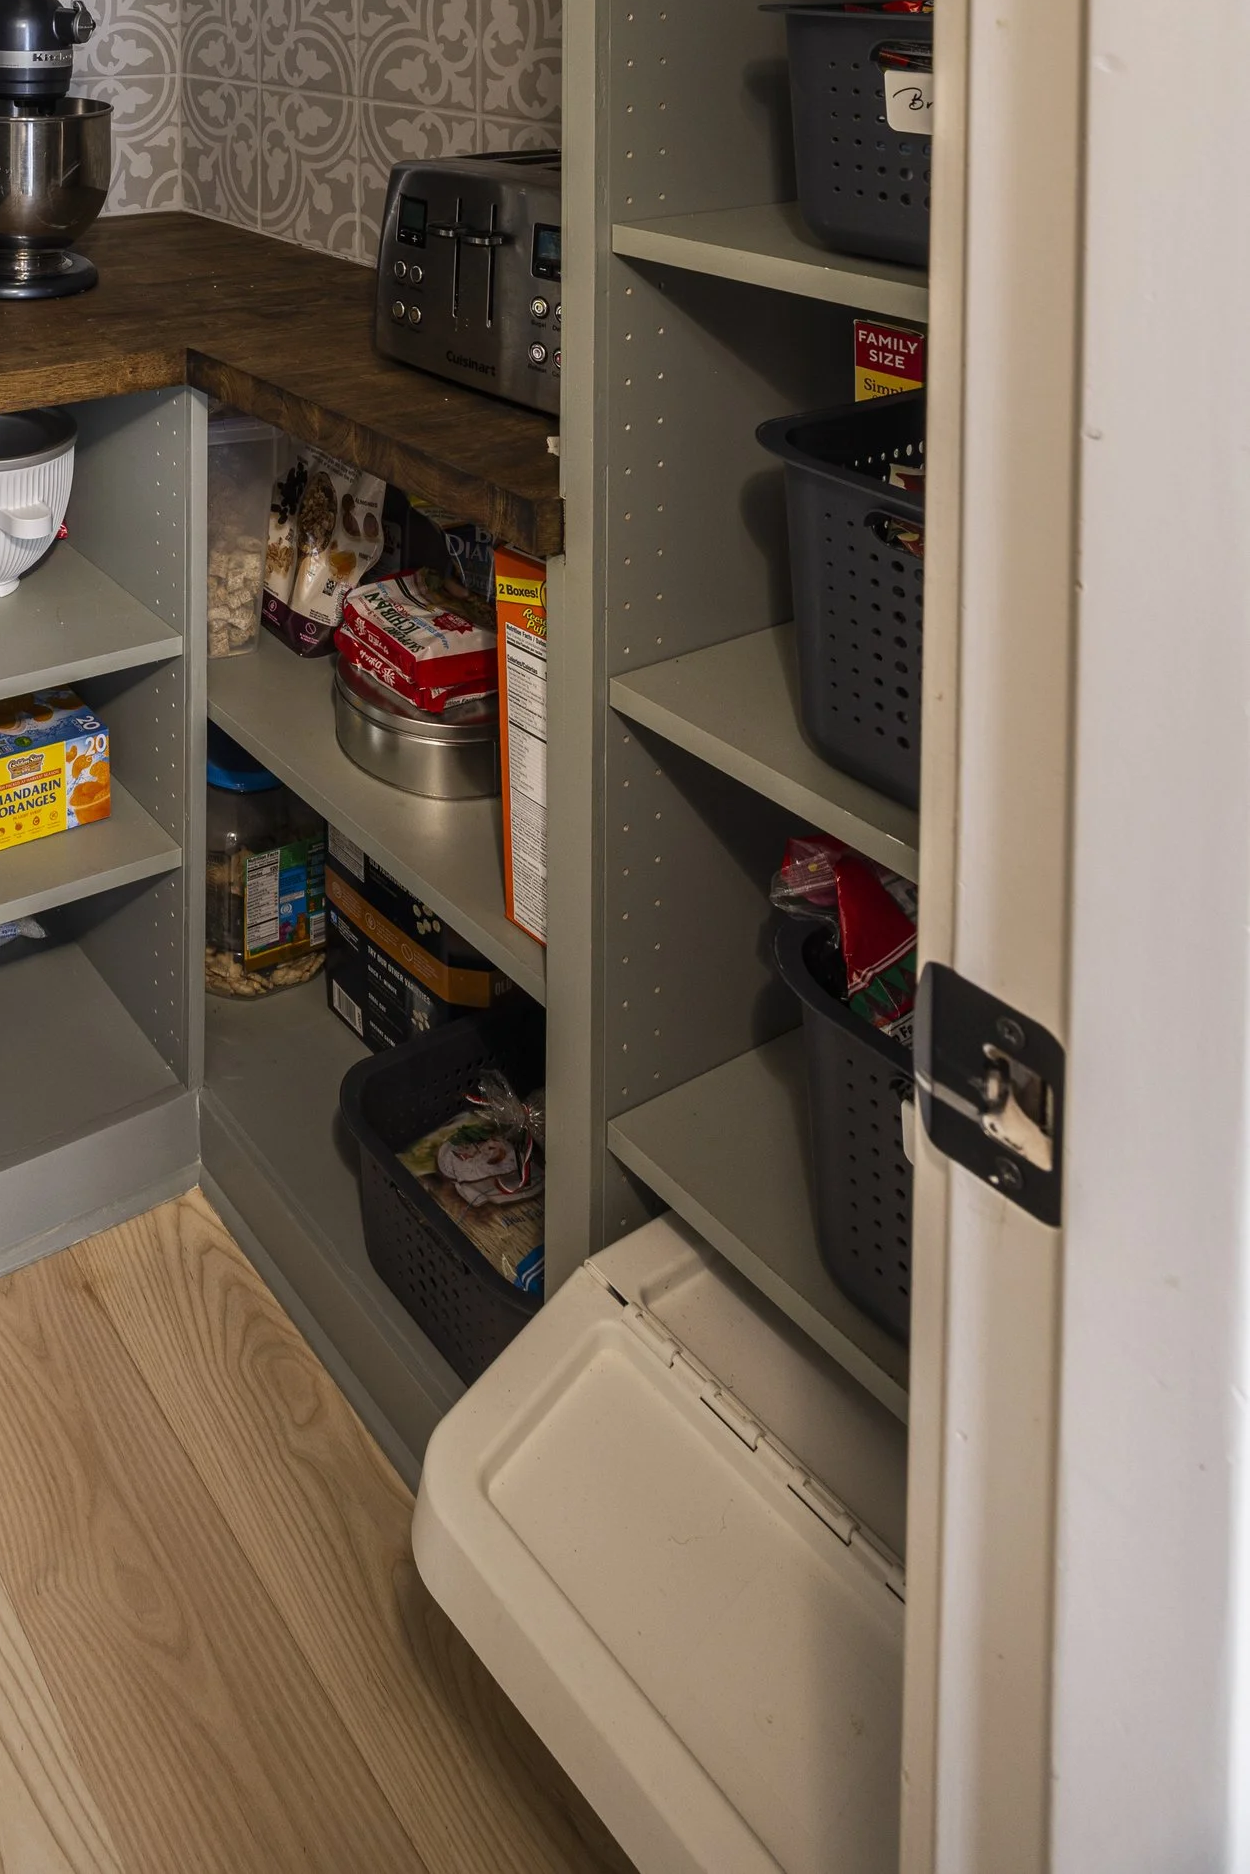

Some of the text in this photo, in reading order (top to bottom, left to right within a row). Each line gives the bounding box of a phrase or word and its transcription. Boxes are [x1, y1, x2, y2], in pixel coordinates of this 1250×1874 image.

[858, 329, 918, 355] FAMILY
[446, 351, 496, 376] Cuisinart
[869, 349, 905, 369] SIZE
[355, 497, 378, 509] ALMONDS
[499, 584, 538, 598] 2 Boxes!
[364, 591, 423, 635] ICHIBAN
[384, 623, 425, 653] SAPPORO
[76, 716, 101, 730] 20
[86, 734, 107, 755] 20
